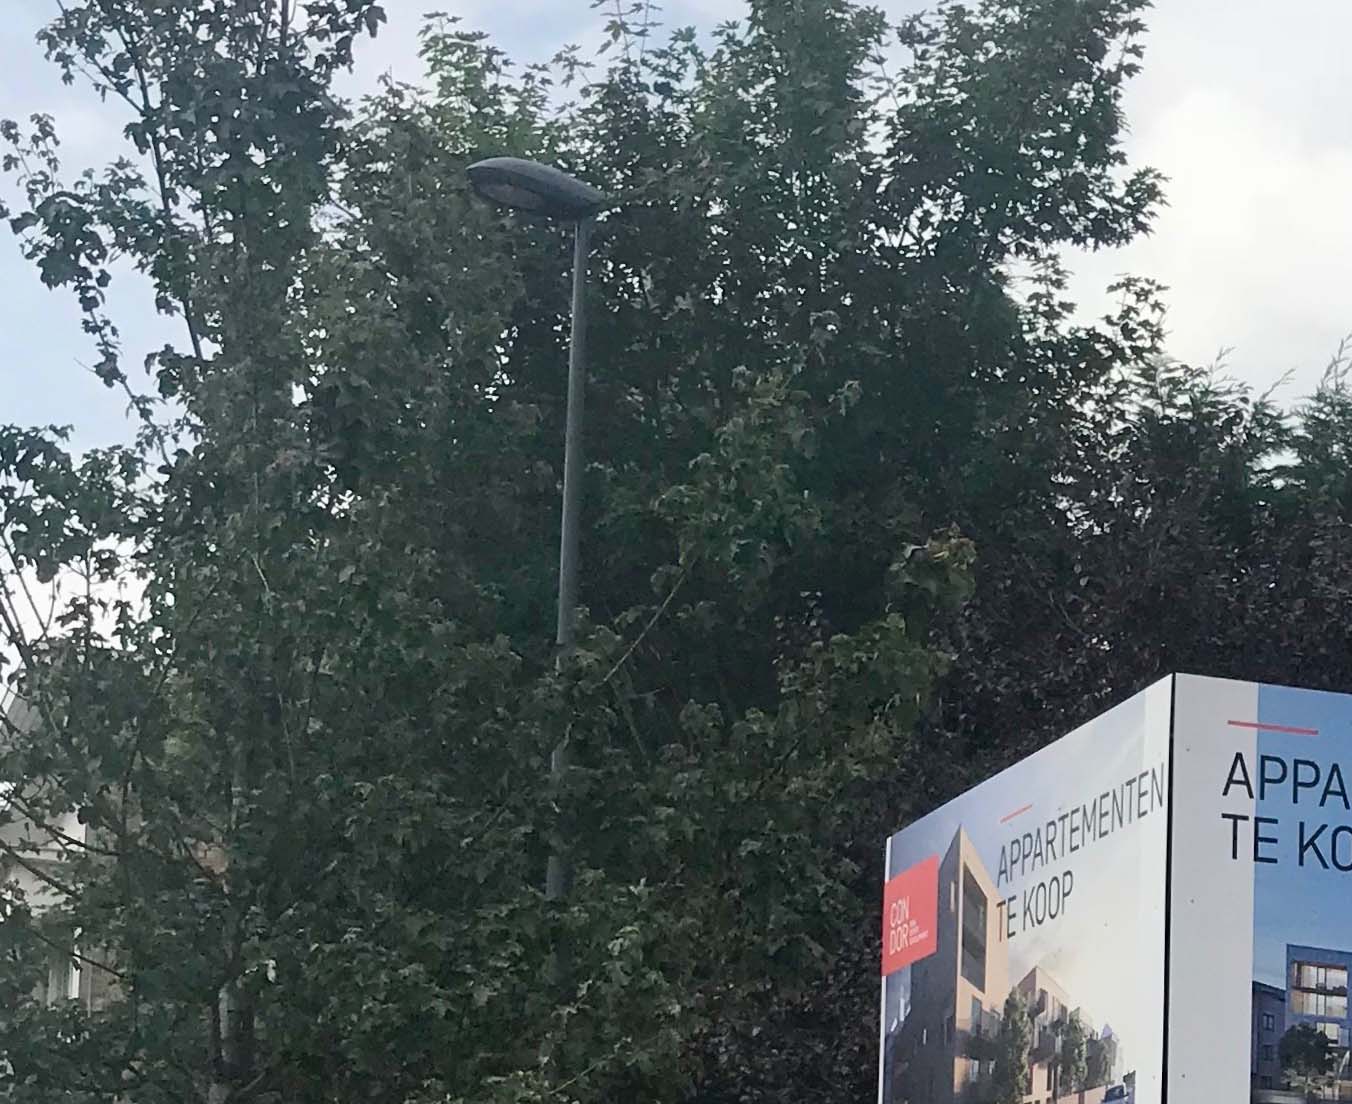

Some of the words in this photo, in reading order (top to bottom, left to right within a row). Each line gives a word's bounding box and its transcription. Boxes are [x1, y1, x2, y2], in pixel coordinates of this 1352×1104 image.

[997, 761, 1166, 888] APPARTEMENTEN
[1222, 813, 1279, 865] TE
[890, 896, 910, 928] CON
[996, 895, 1017, 943] TE
[1022, 870, 1074, 932] KOOP
[889, 923, 909, 957] DOR
